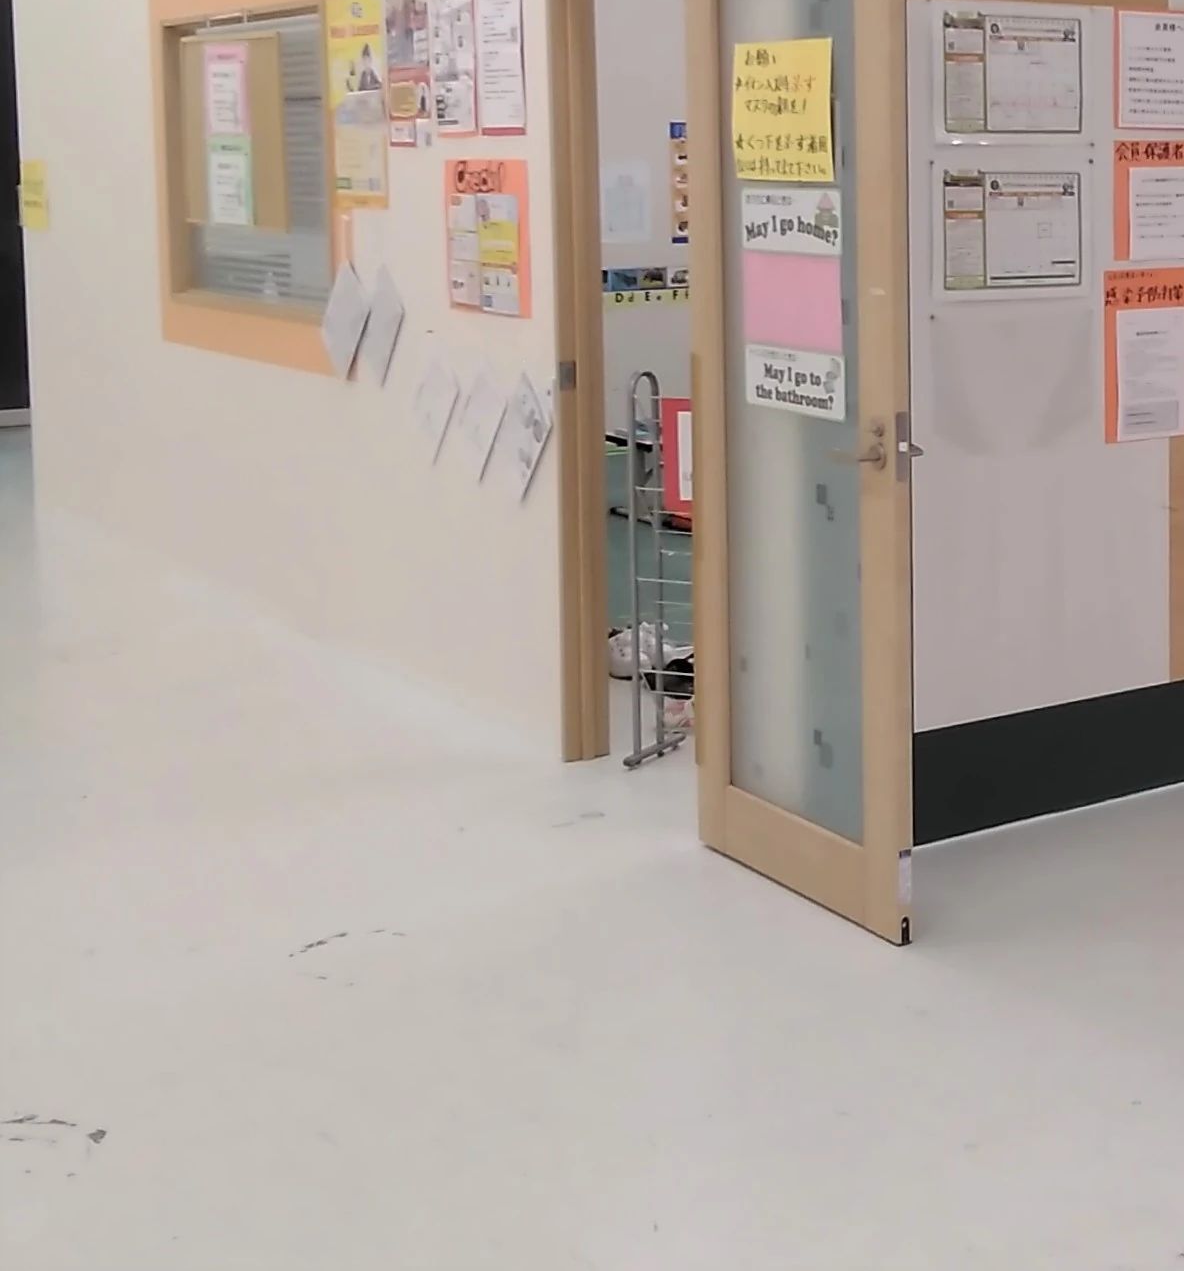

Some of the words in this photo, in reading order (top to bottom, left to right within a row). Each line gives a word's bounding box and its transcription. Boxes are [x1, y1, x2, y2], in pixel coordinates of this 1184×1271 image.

[745, 221, 768, 242] May
[771, 215, 777, 232] I
[780, 217, 794, 237] go
[797, 216, 839, 247] home?
[763, 363, 785, 385] May
[787, 366, 793, 383] I
[795, 371, 807, 388] go
[810, 369, 822, 387] to
[756, 384, 773, 400] the
[775, 387, 834, 411] bathroom?
